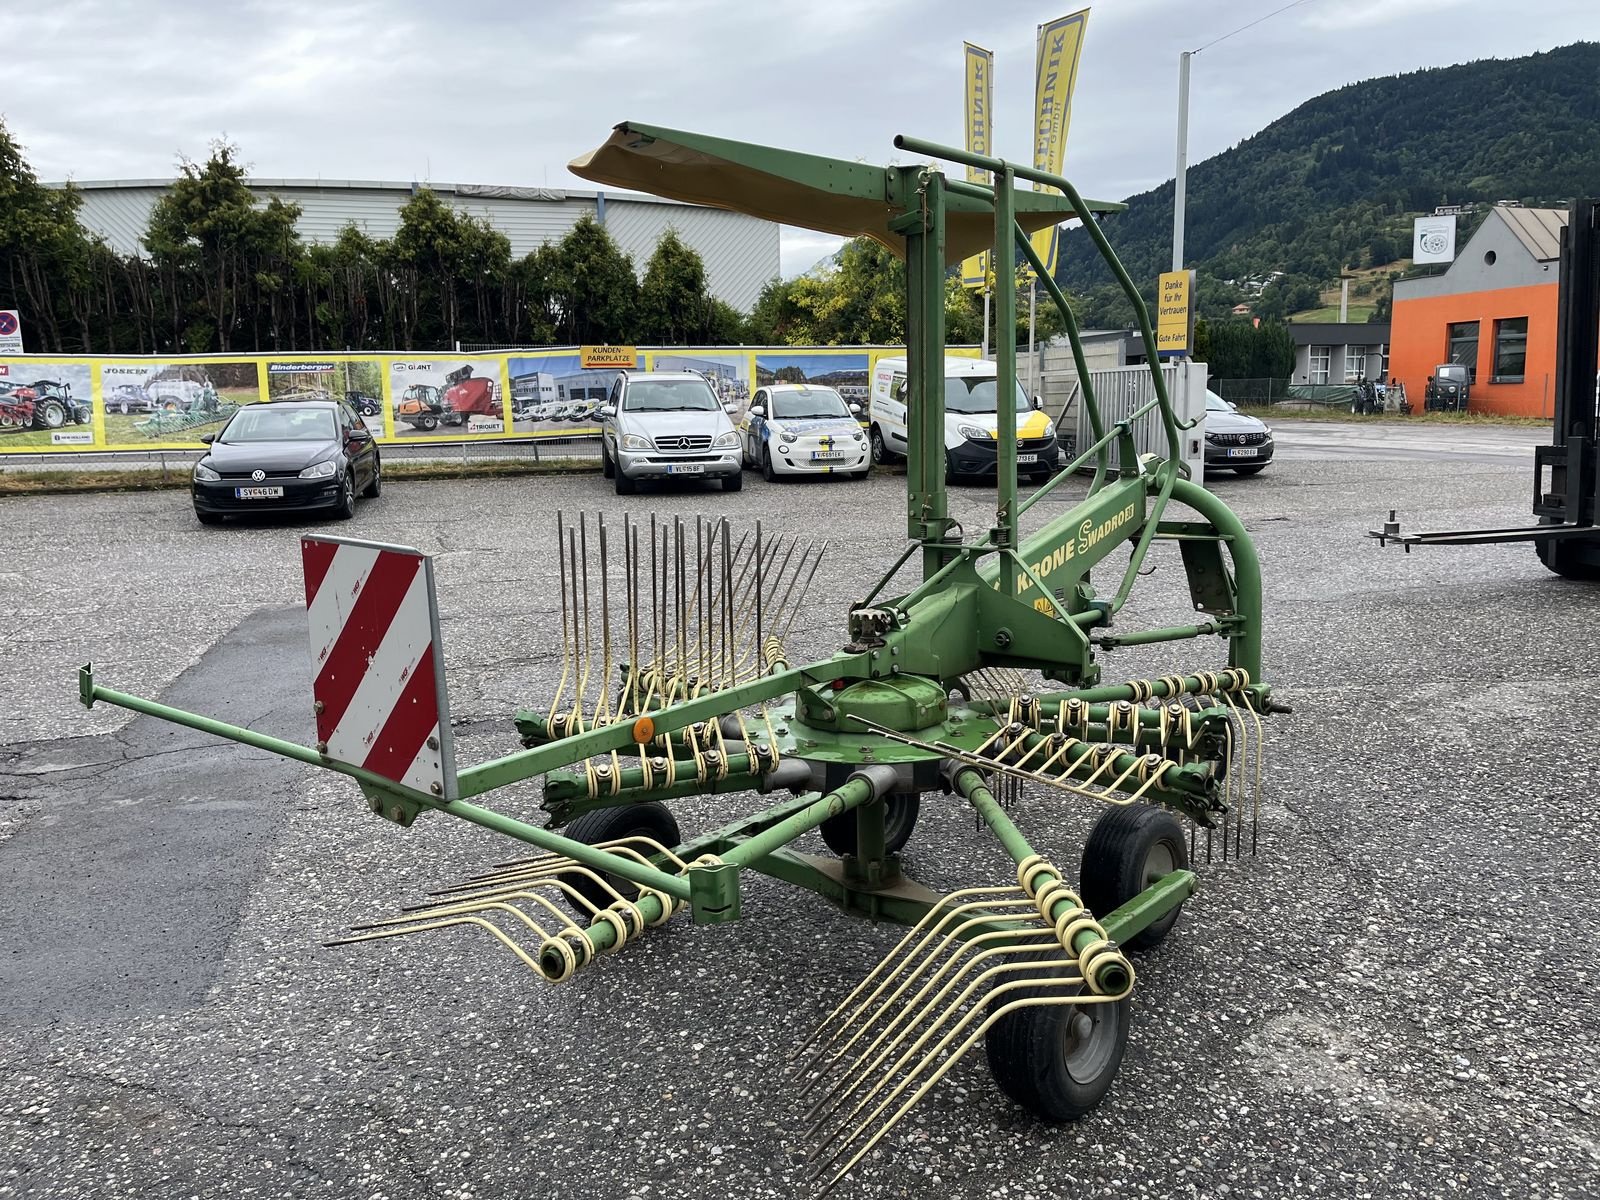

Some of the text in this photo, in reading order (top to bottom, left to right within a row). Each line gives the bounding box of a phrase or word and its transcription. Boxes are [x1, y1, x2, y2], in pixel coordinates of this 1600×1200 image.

[1165, 280, 1182, 290] Danke
[1164, 292, 1182, 302] für Ihr
[1160, 306, 1187, 315] Vertrauen
[1159, 333, 1186, 342] Gute Fahrt
[1017, 538, 1076, 595] KRONE
